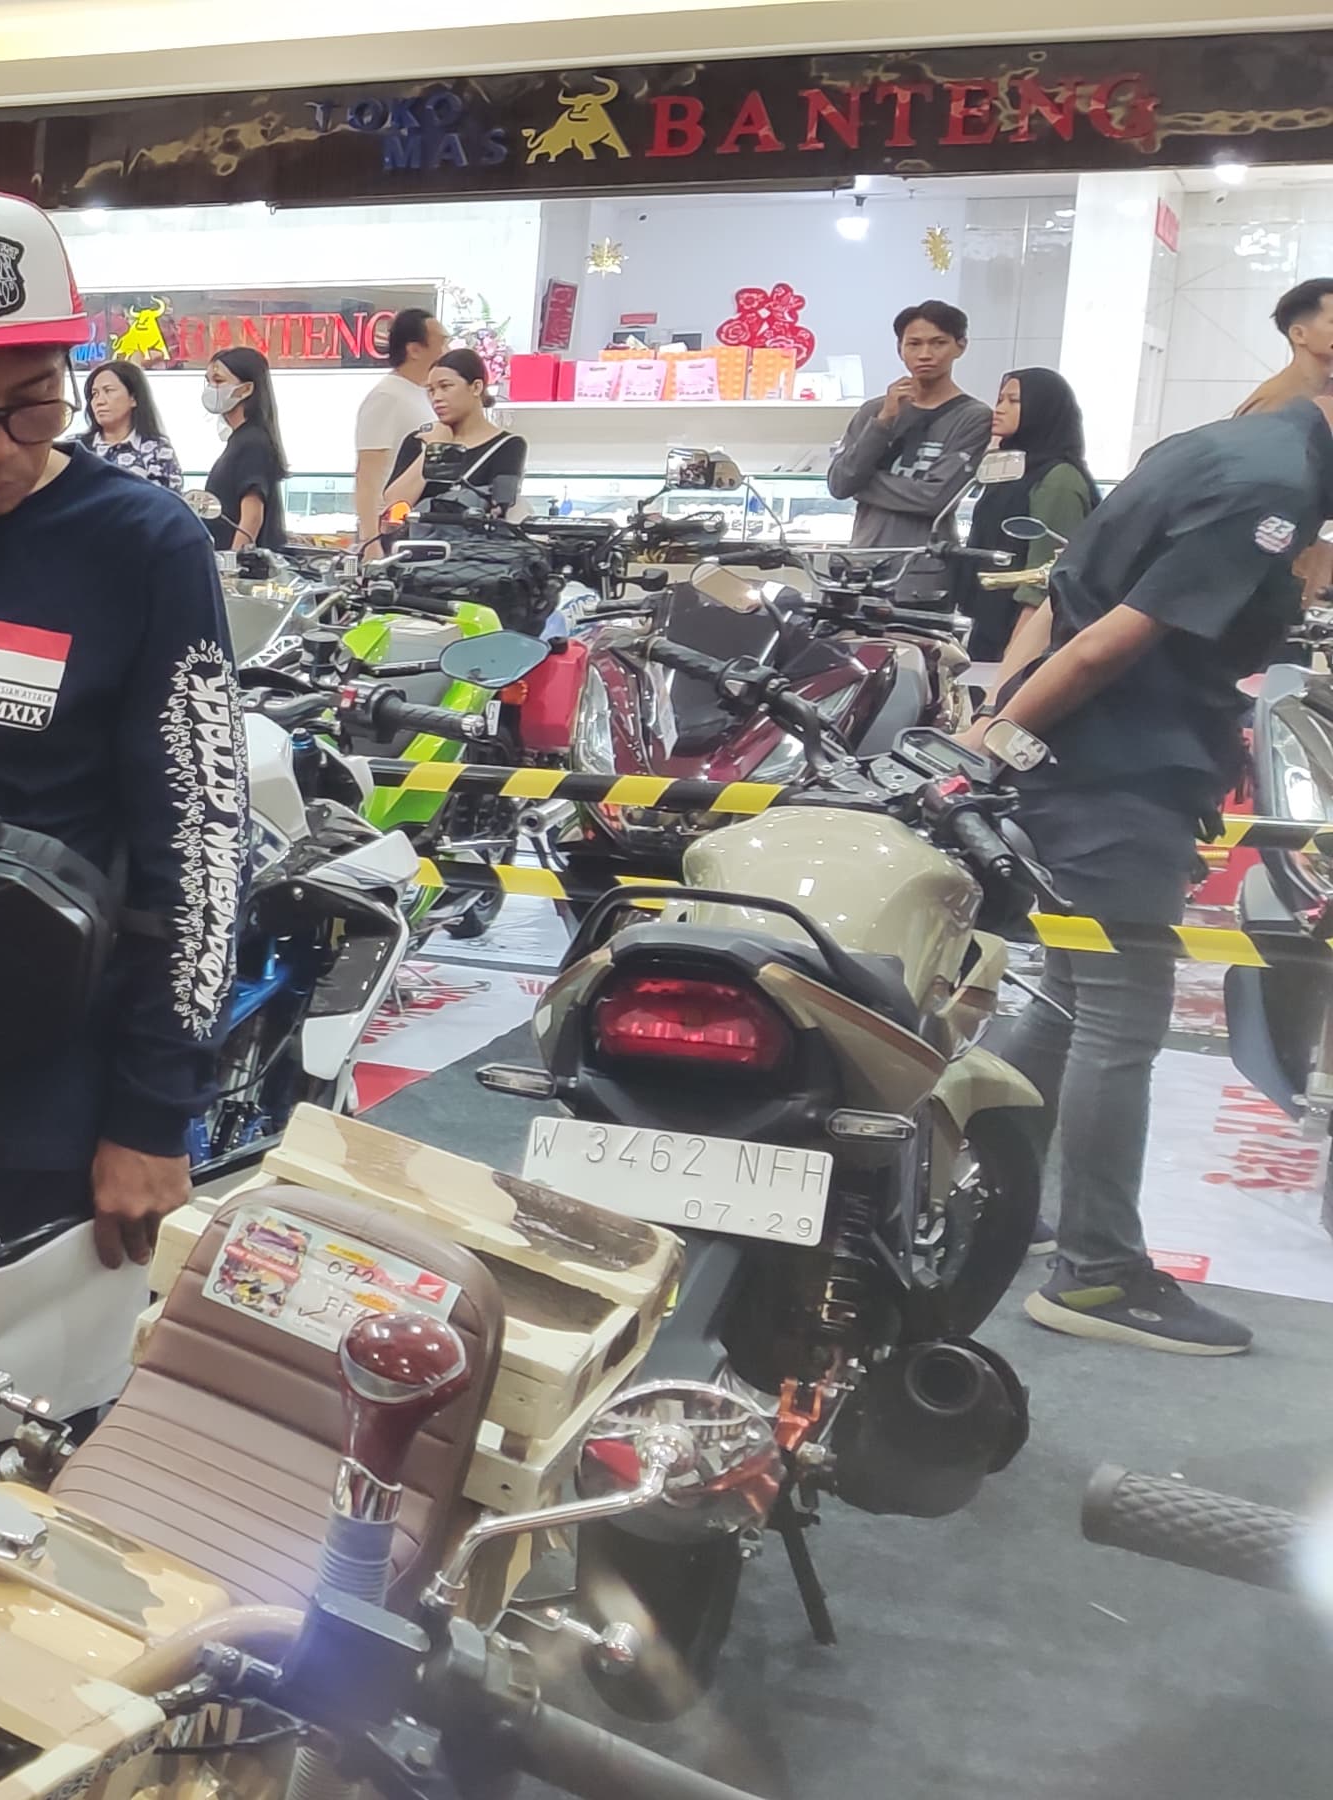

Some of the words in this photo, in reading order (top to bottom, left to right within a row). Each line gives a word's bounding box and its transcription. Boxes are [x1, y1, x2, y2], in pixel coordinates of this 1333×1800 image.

[304, 91, 463, 134] TOKO
[385, 128, 509, 170] MAS
[645, 73, 1157, 159] BANTENG
[189, 672, 238, 814] ATTACK
[194, 821, 239, 1012] INDONESIAN
[532, 1120, 561, 1159] W
[585, 1126, 708, 1177] 3462
[735, 1143, 828, 1196] NFH
